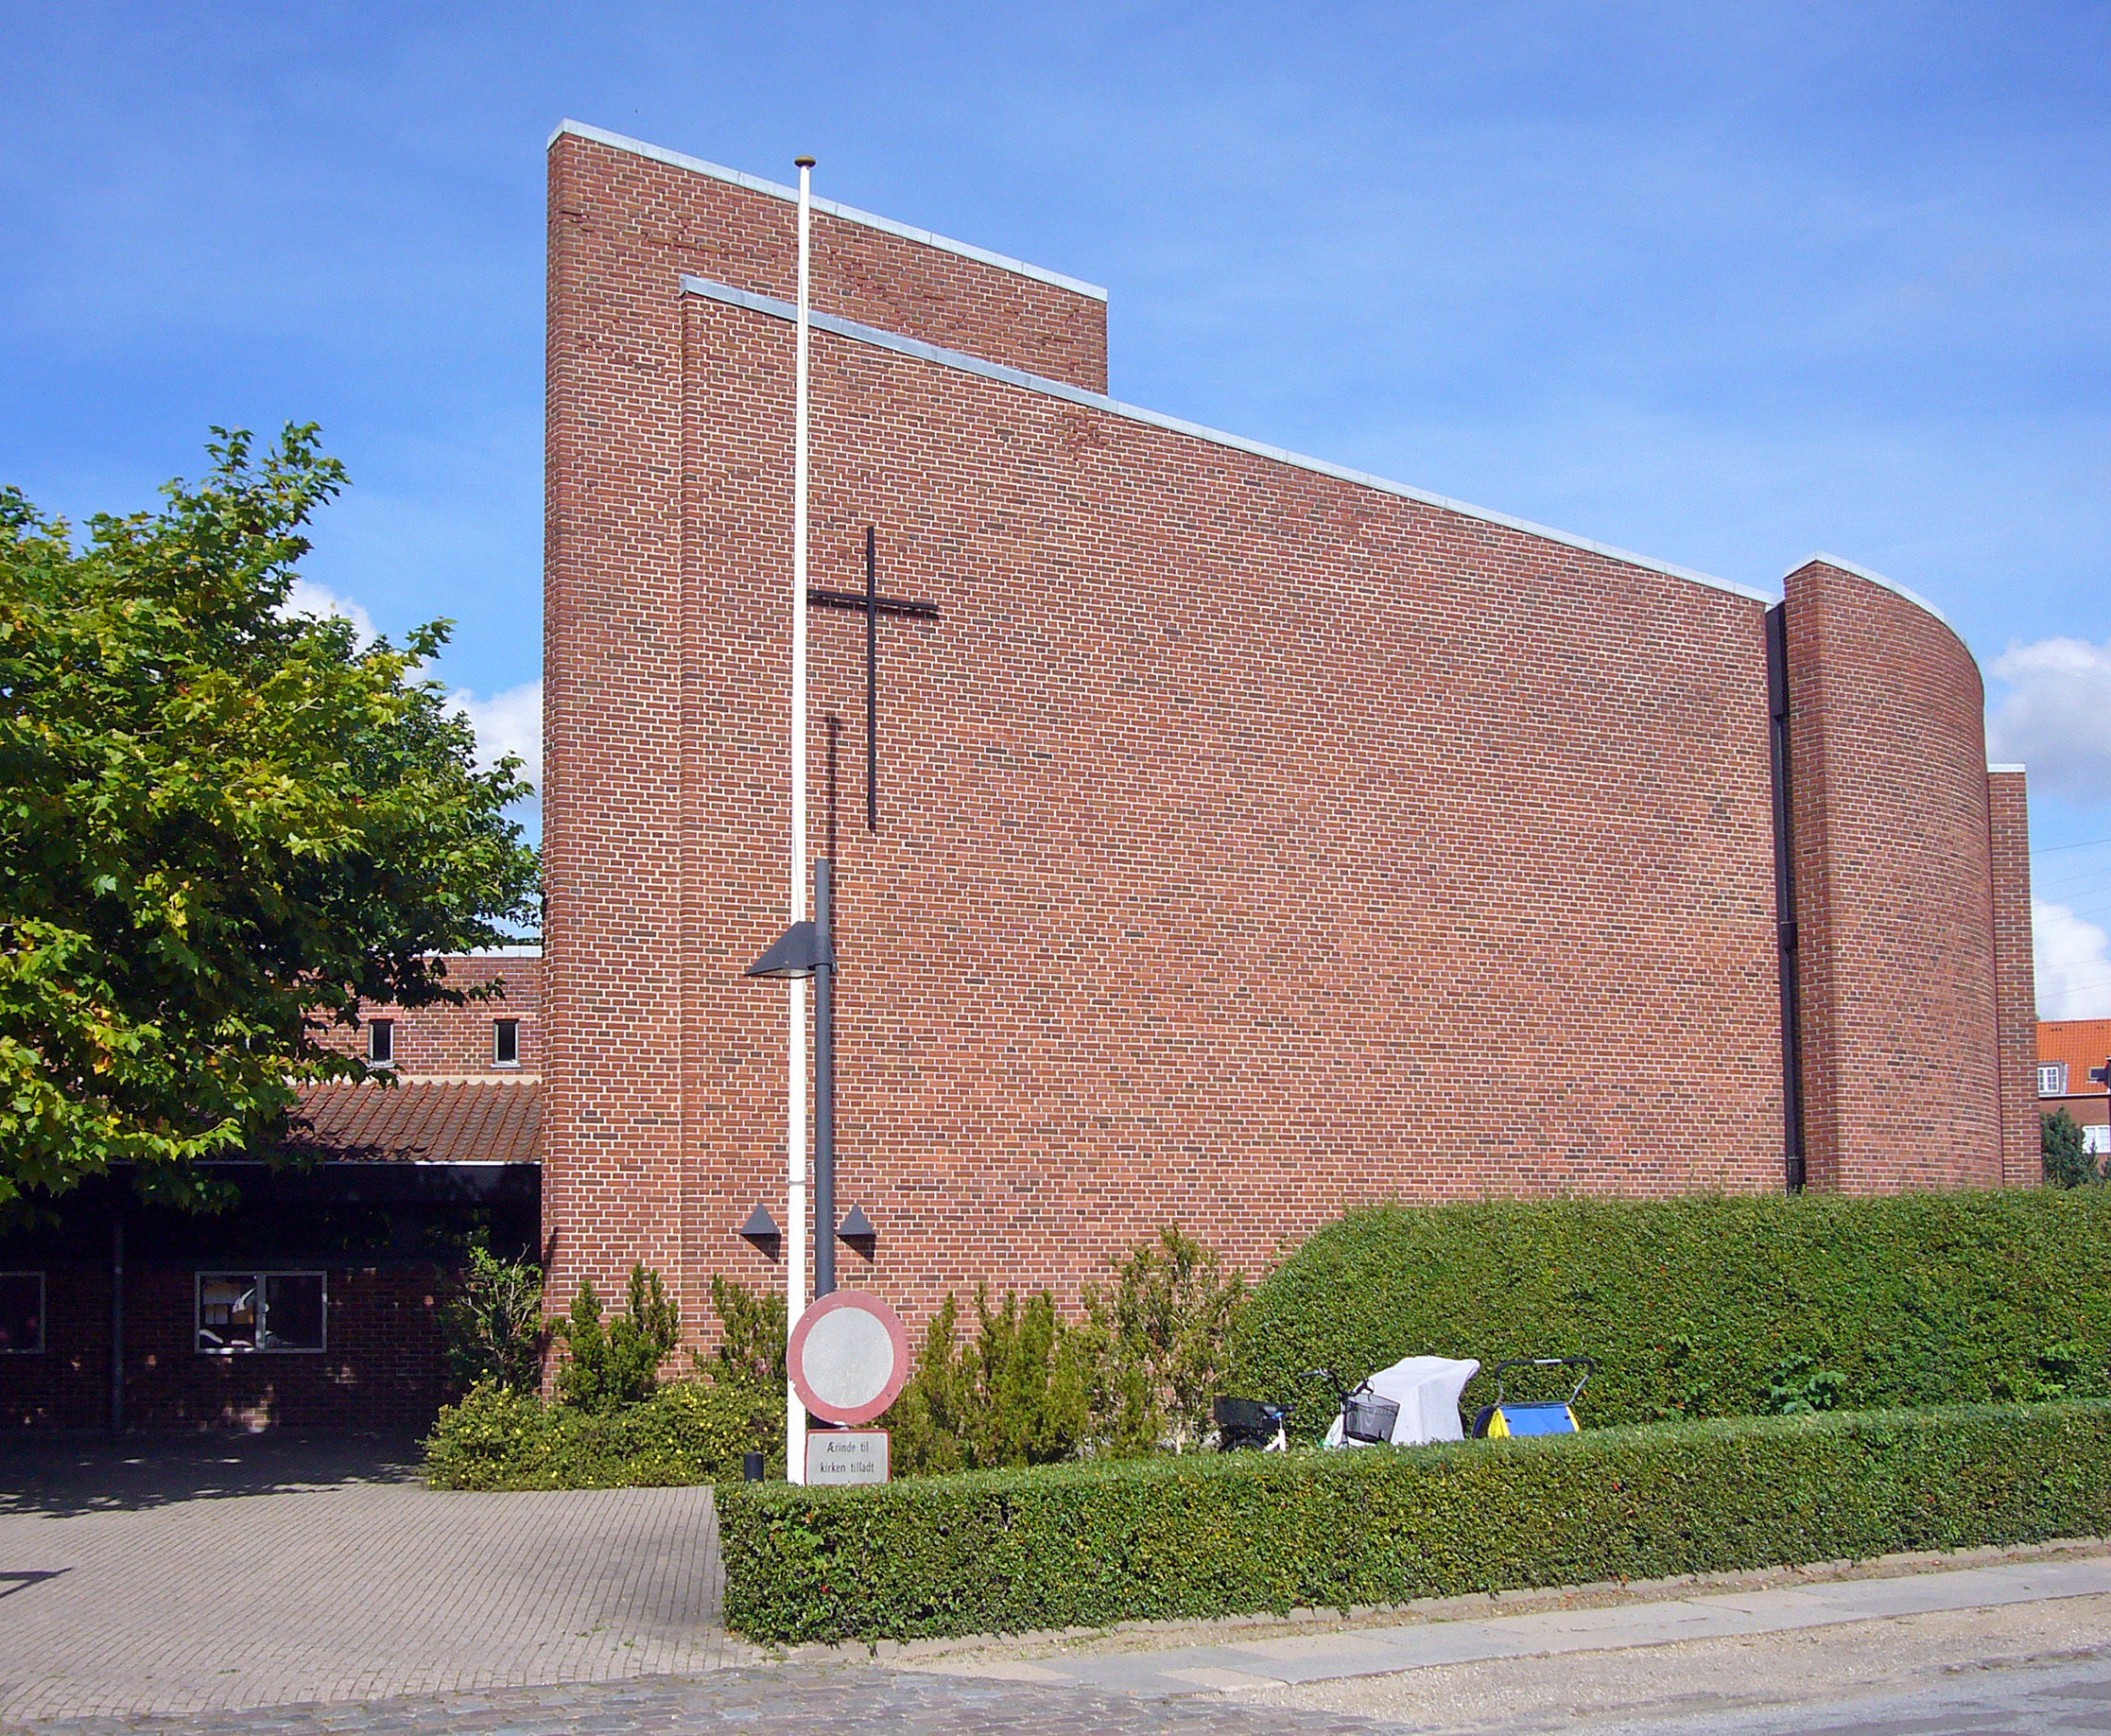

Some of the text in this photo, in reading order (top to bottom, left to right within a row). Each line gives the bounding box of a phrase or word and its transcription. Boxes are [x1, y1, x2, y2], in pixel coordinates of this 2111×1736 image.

[826, 1441, 869, 1452] Ærinde til
[820, 1461, 874, 1473] kirken tilladt
